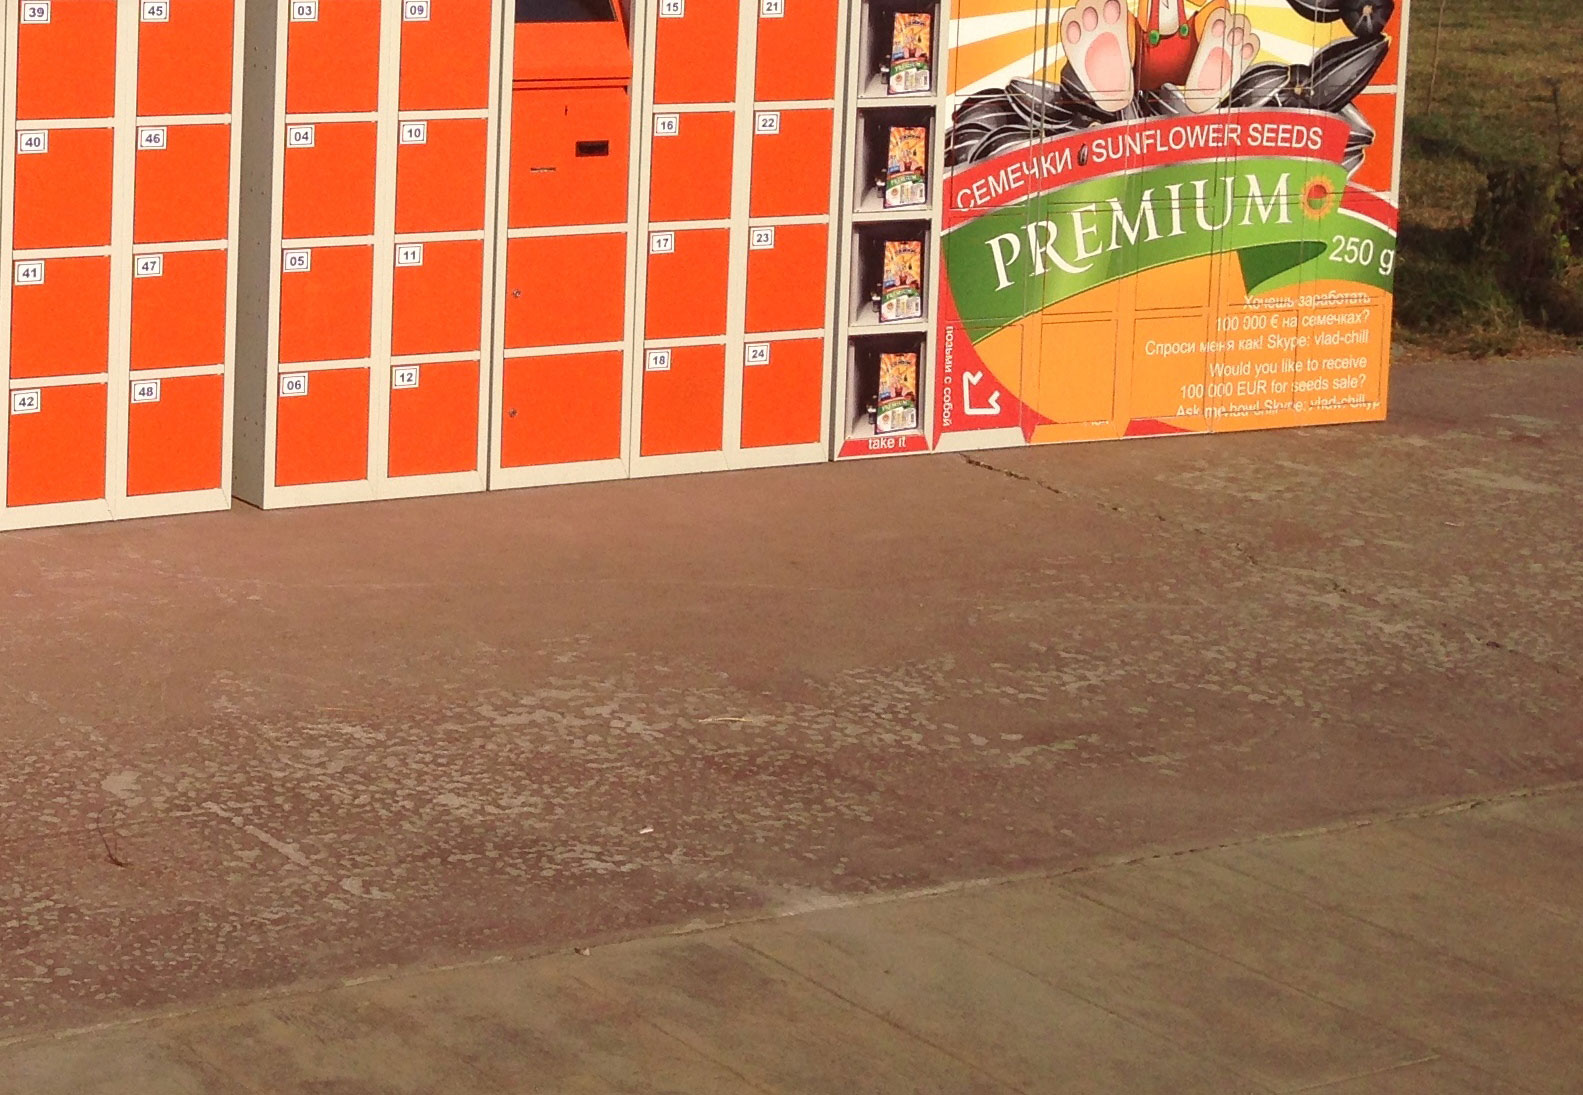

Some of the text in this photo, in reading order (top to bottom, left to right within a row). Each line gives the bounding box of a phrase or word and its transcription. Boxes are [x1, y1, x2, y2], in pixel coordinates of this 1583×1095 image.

[147, 5, 163, 17] 45
[297, 5, 312, 16] 03
[409, 5, 424, 16] 09
[666, 2, 679, 12] 15
[766, 1, 778, 12] 21
[28, 7, 45, 18] 39
[660, 120, 674, 131] 16
[761, 118, 775, 128] 22
[145, 133, 161, 144] 46
[294, 131, 309, 142] 04
[407, 128, 421, 138] 10
[24, 136, 41, 148] 40
[956, 148, 1072, 211] СЕМЕЧКИ
[1091, 124, 1241, 162] SUNFLOWER
[1247, 122, 1323, 149] SEEDS
[984, 172, 1292, 292] PREMIUM
[656, 238, 669, 248] 17
[756, 233, 769, 243] 23
[403, 250, 416, 260] 11
[1328, 235, 1395, 275] 250 g
[141, 260, 157, 272] 47
[289, 255, 305, 267] 05
[22, 268, 37, 279] 41
[1216, 317, 1239, 332] 100
[1243, 315, 1267, 330] 000
[1282, 316, 1298, 328] на
[1301, 309, 1370, 327] семечках?
[1145, 340, 1196, 357] Спроси
[1238, 335, 1264, 350] как!
[1267, 333, 1311, 351] Skype:
[1314, 328, 1369, 345] vlad-chill
[751, 349, 765, 359] 24
[652, 355, 666, 365] 18
[1209, 355, 1368, 379] Would you like to receive
[399, 372, 413, 383] 12
[944, 376, 952, 384] с
[286, 379, 302, 391] 06
[1180, 373, 1367, 399] 100 000 EUR for seeds sale?
[138, 386, 154, 397] 48
[18, 396, 35, 407] 42
[942, 387, 953, 427] собой
[868, 436, 907, 450] take it
